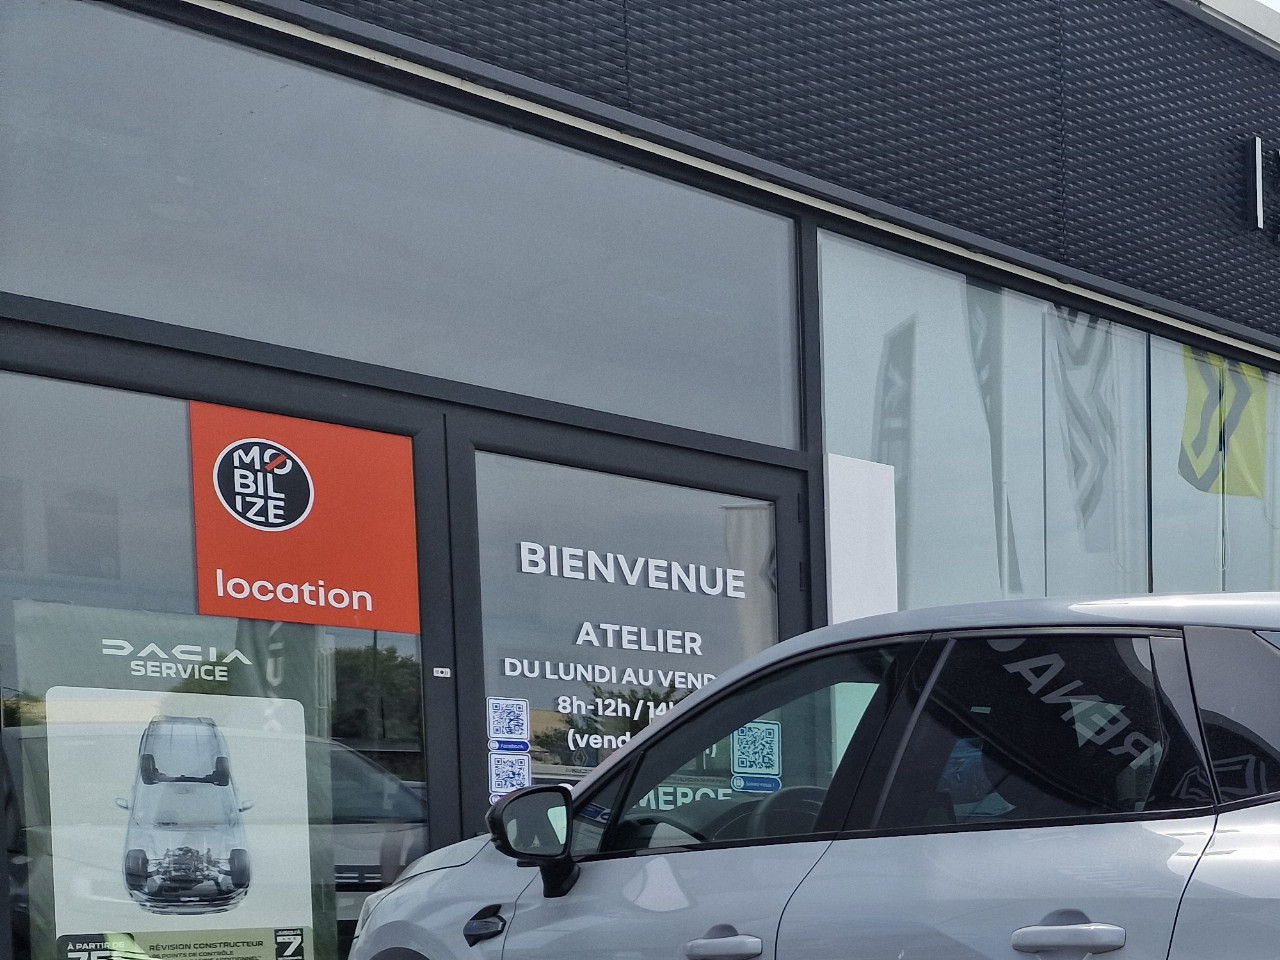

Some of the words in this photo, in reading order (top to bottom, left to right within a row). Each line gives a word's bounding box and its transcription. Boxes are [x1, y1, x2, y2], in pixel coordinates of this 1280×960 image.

[234, 468, 285, 499] BIL
[235, 495, 286, 524] IZE
[520, 541, 746, 599] BIENVENUE
[215, 569, 373, 612] location
[101, 638, 253, 666] DACIA
[576, 621, 703, 656] ATELIER
[130, 660, 228, 682] SERVICE
[504, 657, 540, 678] DU
[545, 660, 617, 684] LUNDI
[621, 663, 653, 686] AU
[658, 669, 718, 691] VEND
[557, 695, 631, 718] 8h-12h
[567, 729, 632, 751] (vend
[76, 941, 110, 950] PARTIR
[112, 941, 125, 949] DE
[149, 943, 192, 952] RÉVISION
[193, 940, 264, 950] CONSTRUCTEUR
[276, 935, 302, 956] 7
